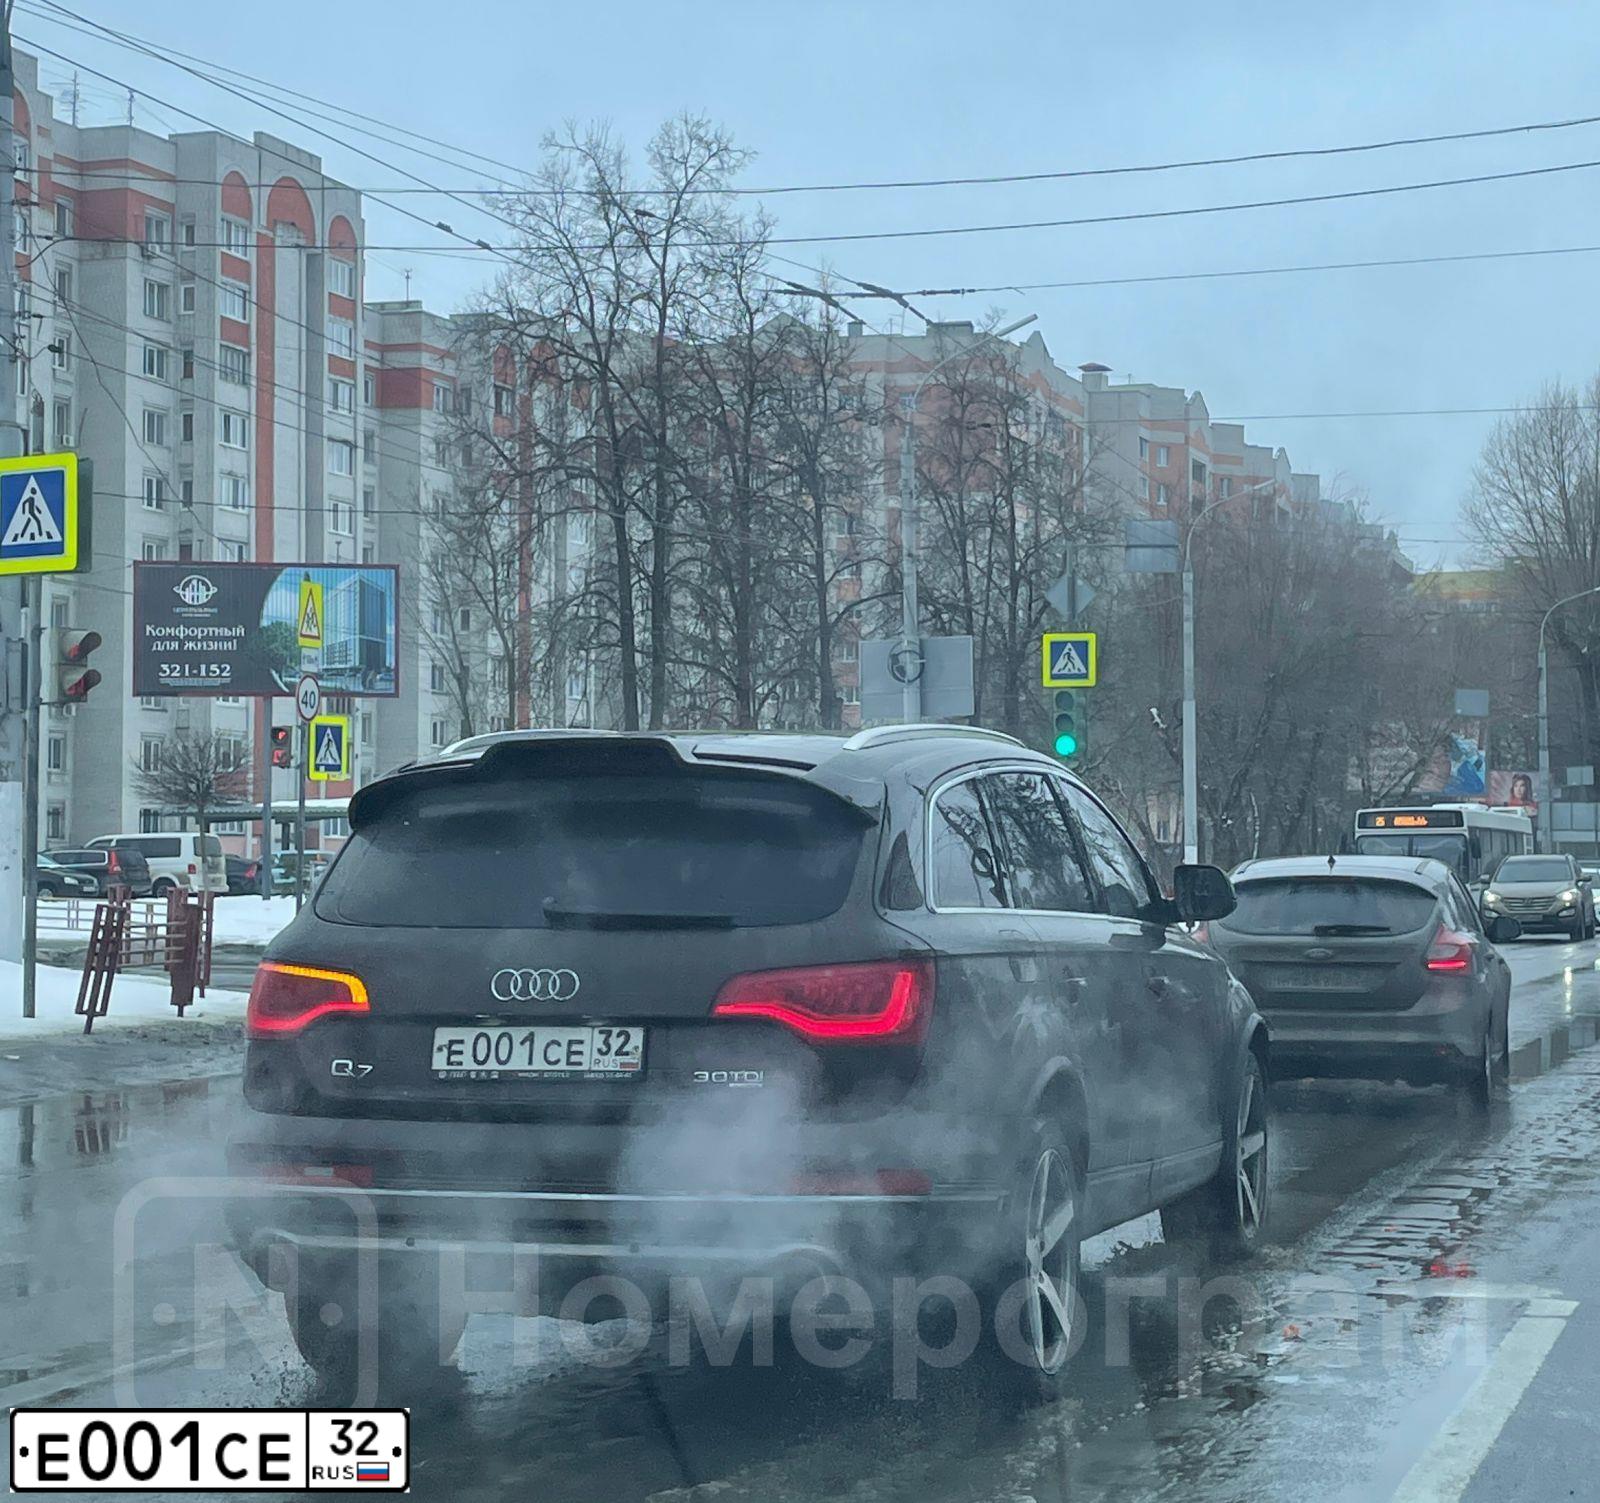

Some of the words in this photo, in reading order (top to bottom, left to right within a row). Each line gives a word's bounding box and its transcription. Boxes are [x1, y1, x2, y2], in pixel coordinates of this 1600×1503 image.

[145, 624, 246, 640] Комфортный
[152, 640, 179, 652] для
[158, 663, 232, 677] 321-152
[301, 690, 317, 709] 40
[446, 1031, 585, 1067] Е001СЕ
[597, 1029, 632, 1057] 32
[331, 1059, 374, 1078] Q7
[593, 1058, 620, 1069] RUS
